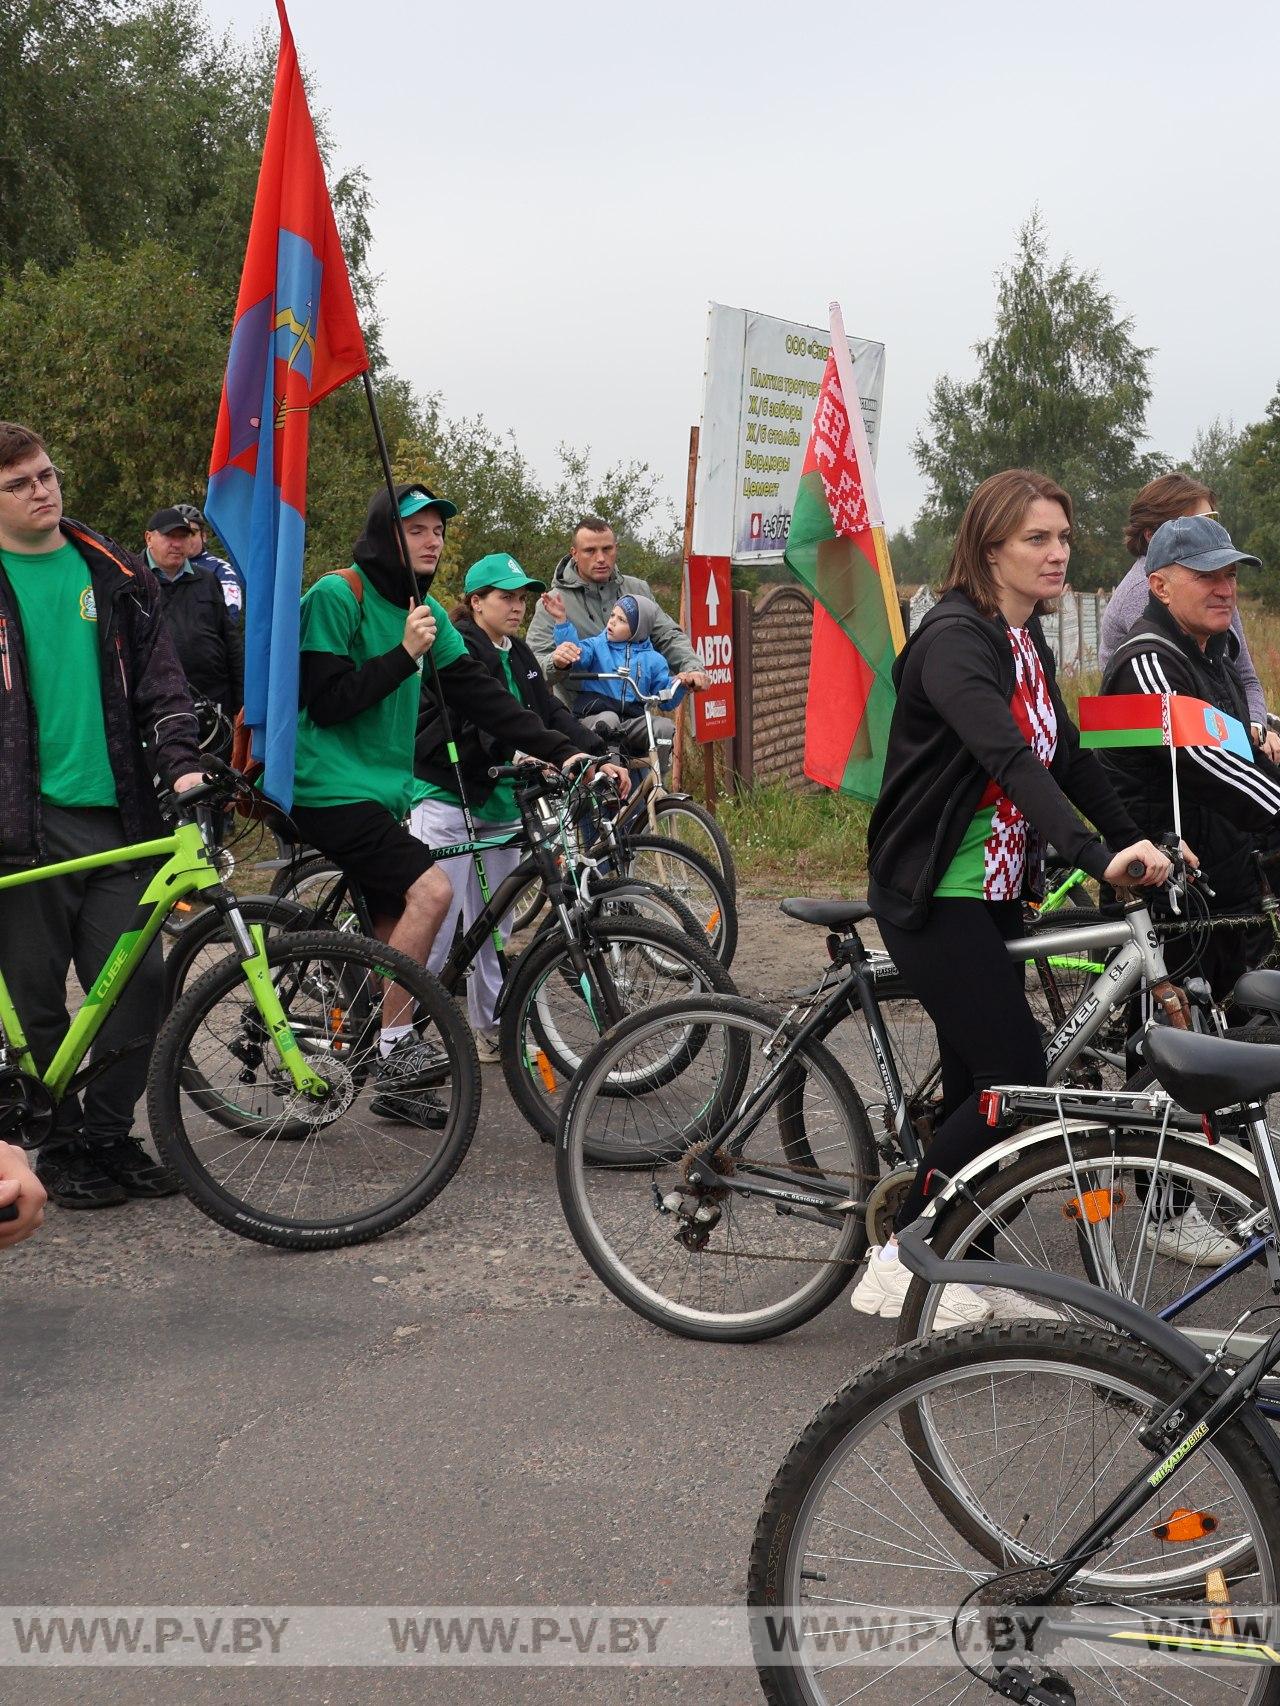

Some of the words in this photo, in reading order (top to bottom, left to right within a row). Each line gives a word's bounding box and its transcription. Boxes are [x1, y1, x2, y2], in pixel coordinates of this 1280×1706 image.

[785, 334, 807, 357] ООО
[769, 400, 803, 423] заборы
[768, 427, 801, 447] столбы
[744, 449, 790, 475] Бордюры
[742, 477, 780, 499] Цемент
[696, 634, 732, 668] АВТО
[96, 948, 129, 999] CUBE
[1109, 961, 1130, 981] SL
[1045, 994, 1100, 1067] ARVEL
